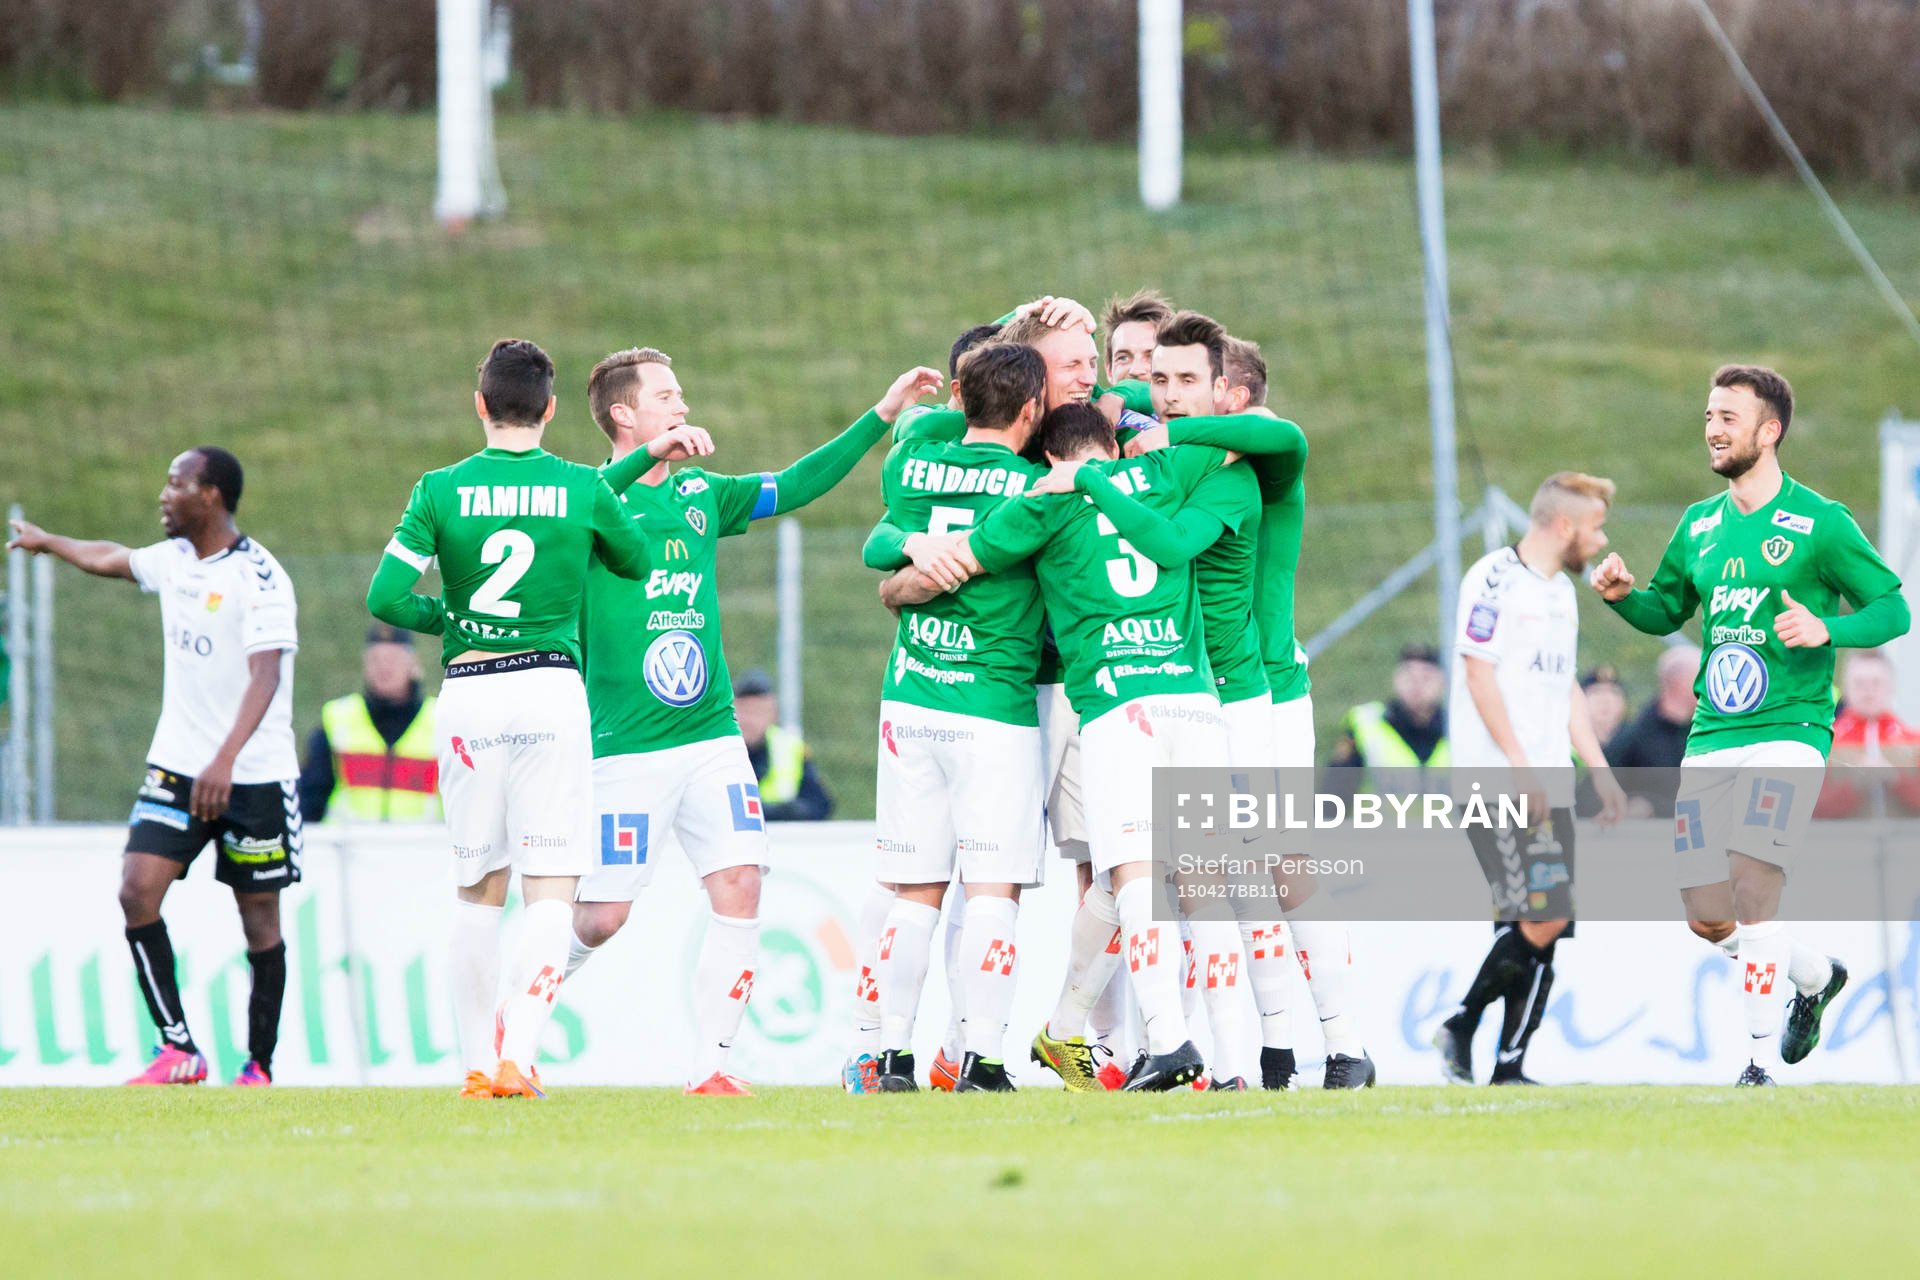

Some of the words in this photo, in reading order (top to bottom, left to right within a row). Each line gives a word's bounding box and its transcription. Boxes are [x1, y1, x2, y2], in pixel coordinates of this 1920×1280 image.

[901, 458, 1028, 498] FENDRICH
[457, 485, 568, 518] TAMIMI
[469, 529, 536, 618] 2
[909, 613, 976, 650] AQUA
[1101, 617, 1183, 646] AQUA
[450, 663, 487, 675] GANT
[495, 654, 541, 669] GANT
[469, 732, 556, 752] Riksbyggen
[895, 725, 975, 742] Riksbyggen
[529, 834, 568, 848] Elmia
[882, 838, 917, 854] Elmia
[964, 838, 1000, 852] Elmia
